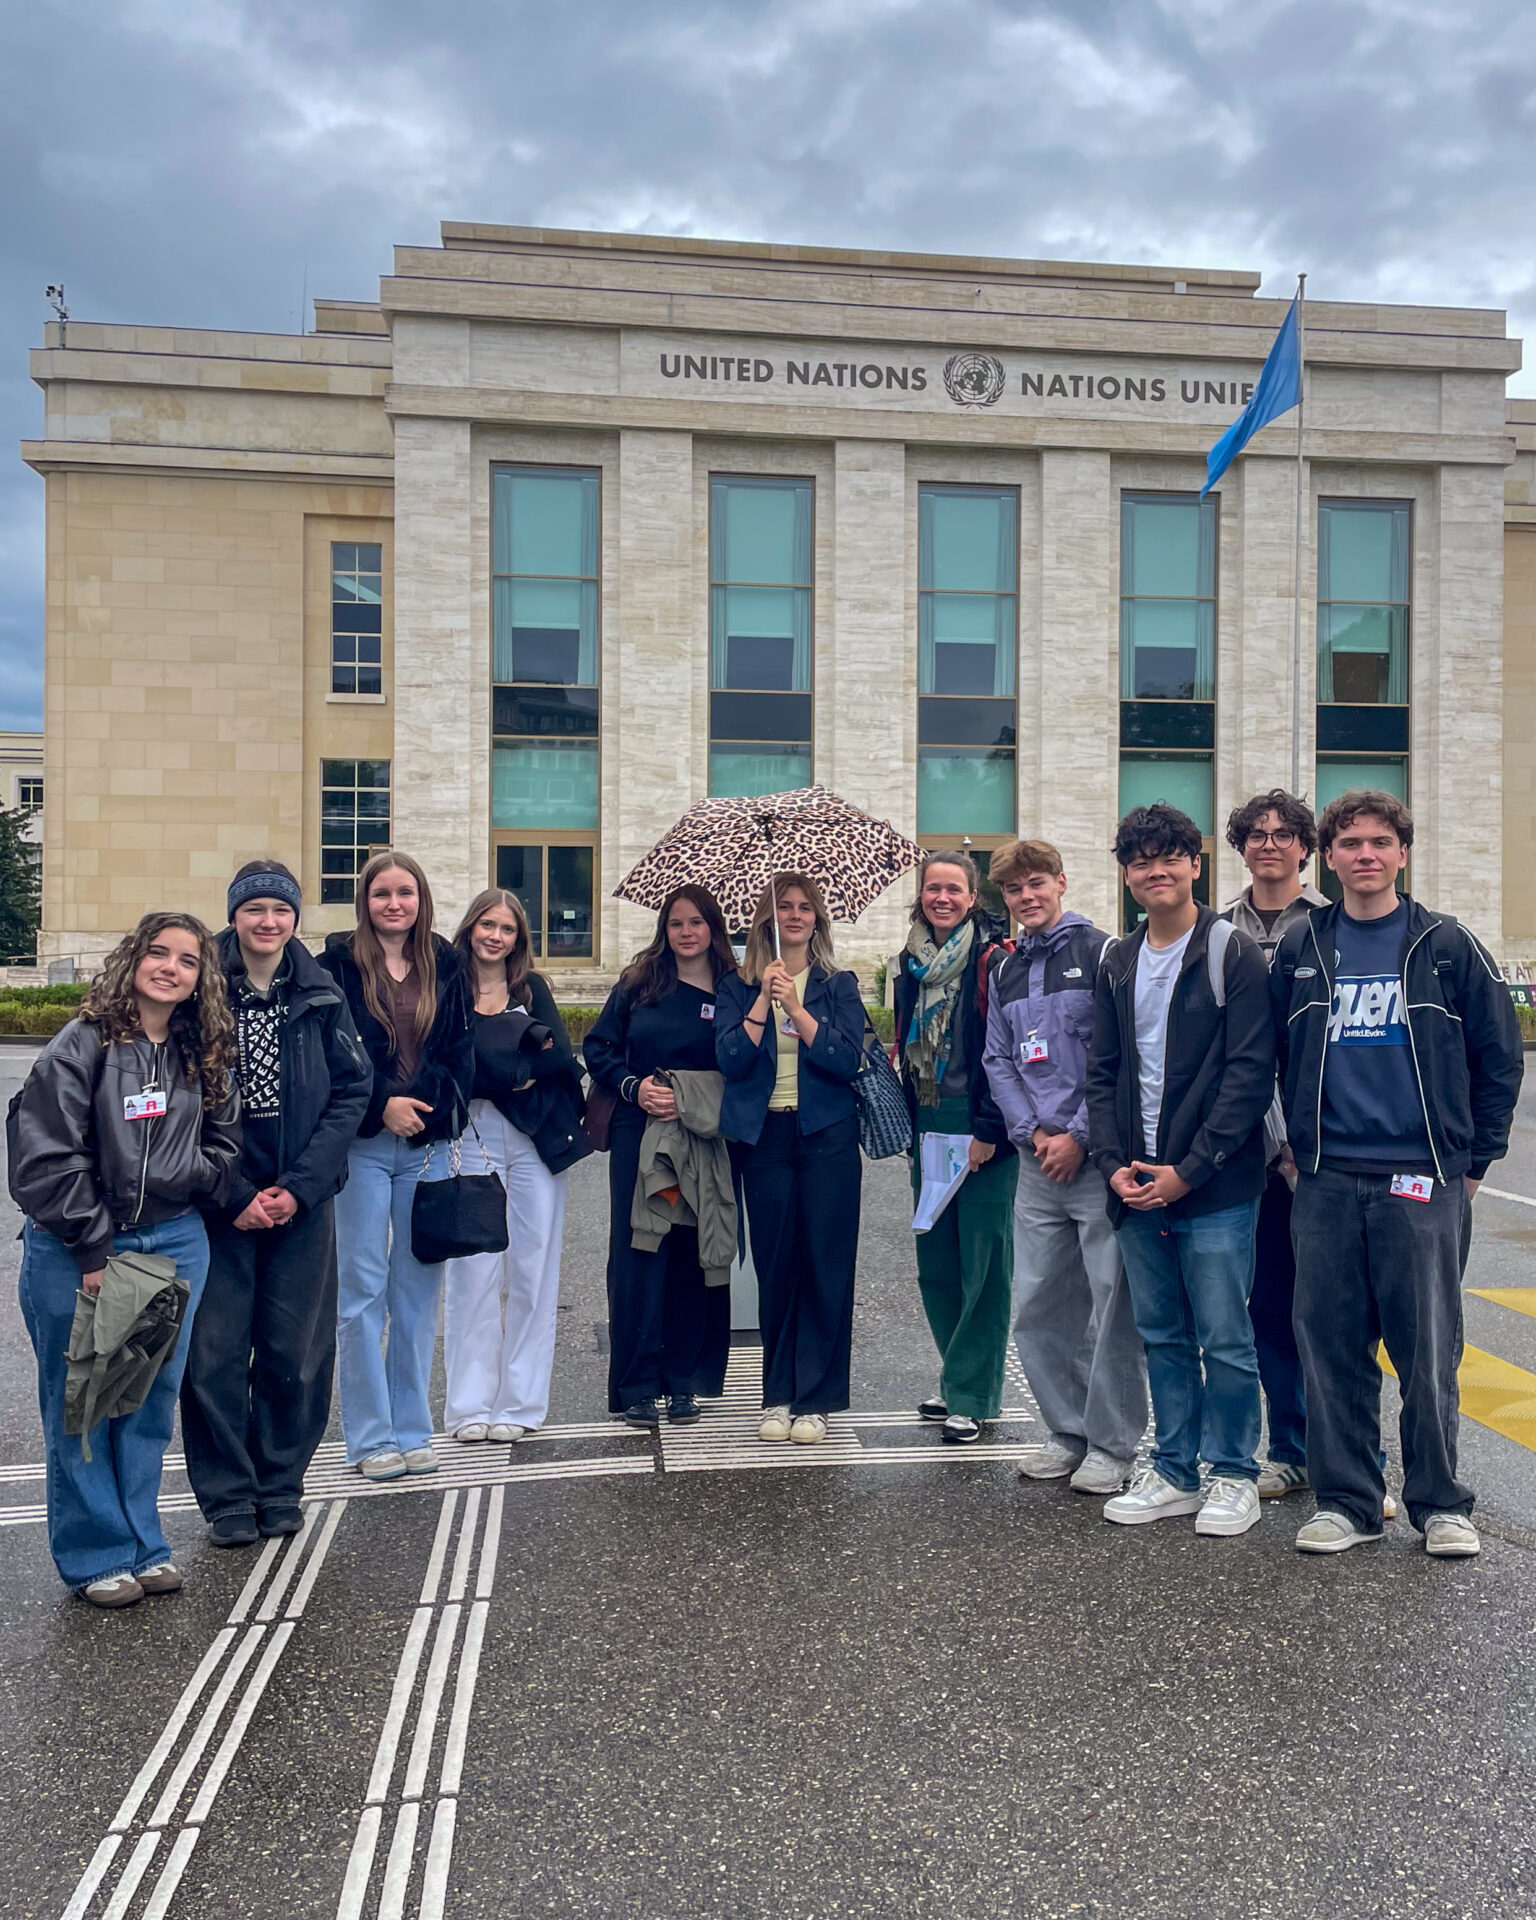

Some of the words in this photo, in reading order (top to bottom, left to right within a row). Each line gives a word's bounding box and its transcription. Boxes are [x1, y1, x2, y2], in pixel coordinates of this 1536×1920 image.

[660, 354, 773, 382] UNITED
[786, 360, 927, 391] NATIONS
[1021, 372, 1166, 402] NATIONS
[1180, 380, 1254, 405] UNIE
